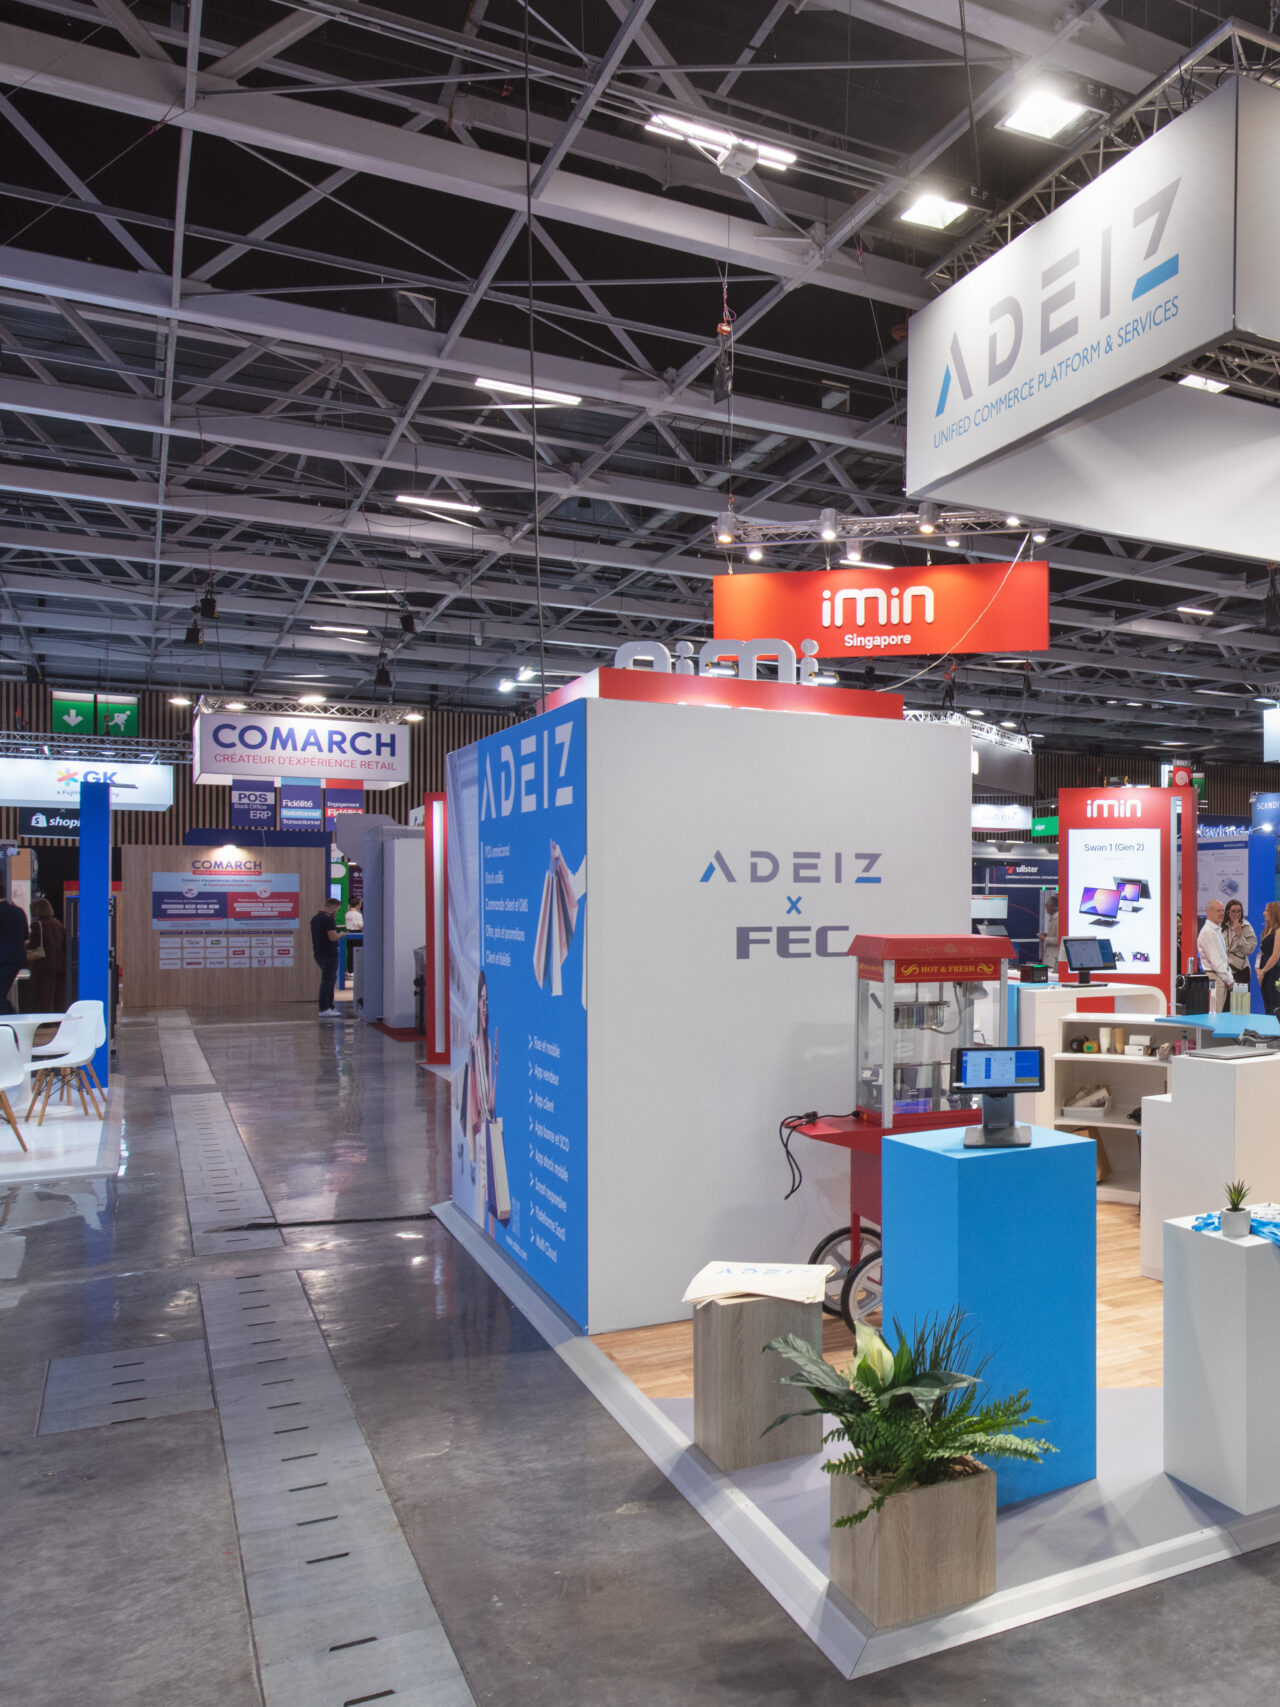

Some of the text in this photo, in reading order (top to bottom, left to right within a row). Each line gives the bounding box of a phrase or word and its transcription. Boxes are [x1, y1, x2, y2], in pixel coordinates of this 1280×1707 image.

[934, 176, 1182, 418] ADEIZ
[934, 296, 1179, 448] UNIFIED COMMERCE PLATFORM & SERVICES
[821, 585, 935, 627] imin
[844, 633, 911, 649] Singapore
[212, 723, 396, 757] COMARCH
[214, 752, 397, 771] CRÉATEUR D'EXPÉRIENCE RETAIL
[83, 770, 118, 784] GK
[480, 721, 574, 822] ADEIZ
[238, 792, 268, 803] POS
[283, 799, 313, 809] Fidélité
[250, 811, 272, 820] ERP
[1086, 799, 1142, 818] imin
[1084, 843, 1107, 852] Swan
[1115, 842, 1135, 852] (Gen
[1136, 842, 1145, 852] 2)
[192, 860, 263, 870] COMARCH
[700, 849, 883, 884] ADEIZ
[735, 925, 850, 960] FEC
[948, 965, 975, 973] FRESH
